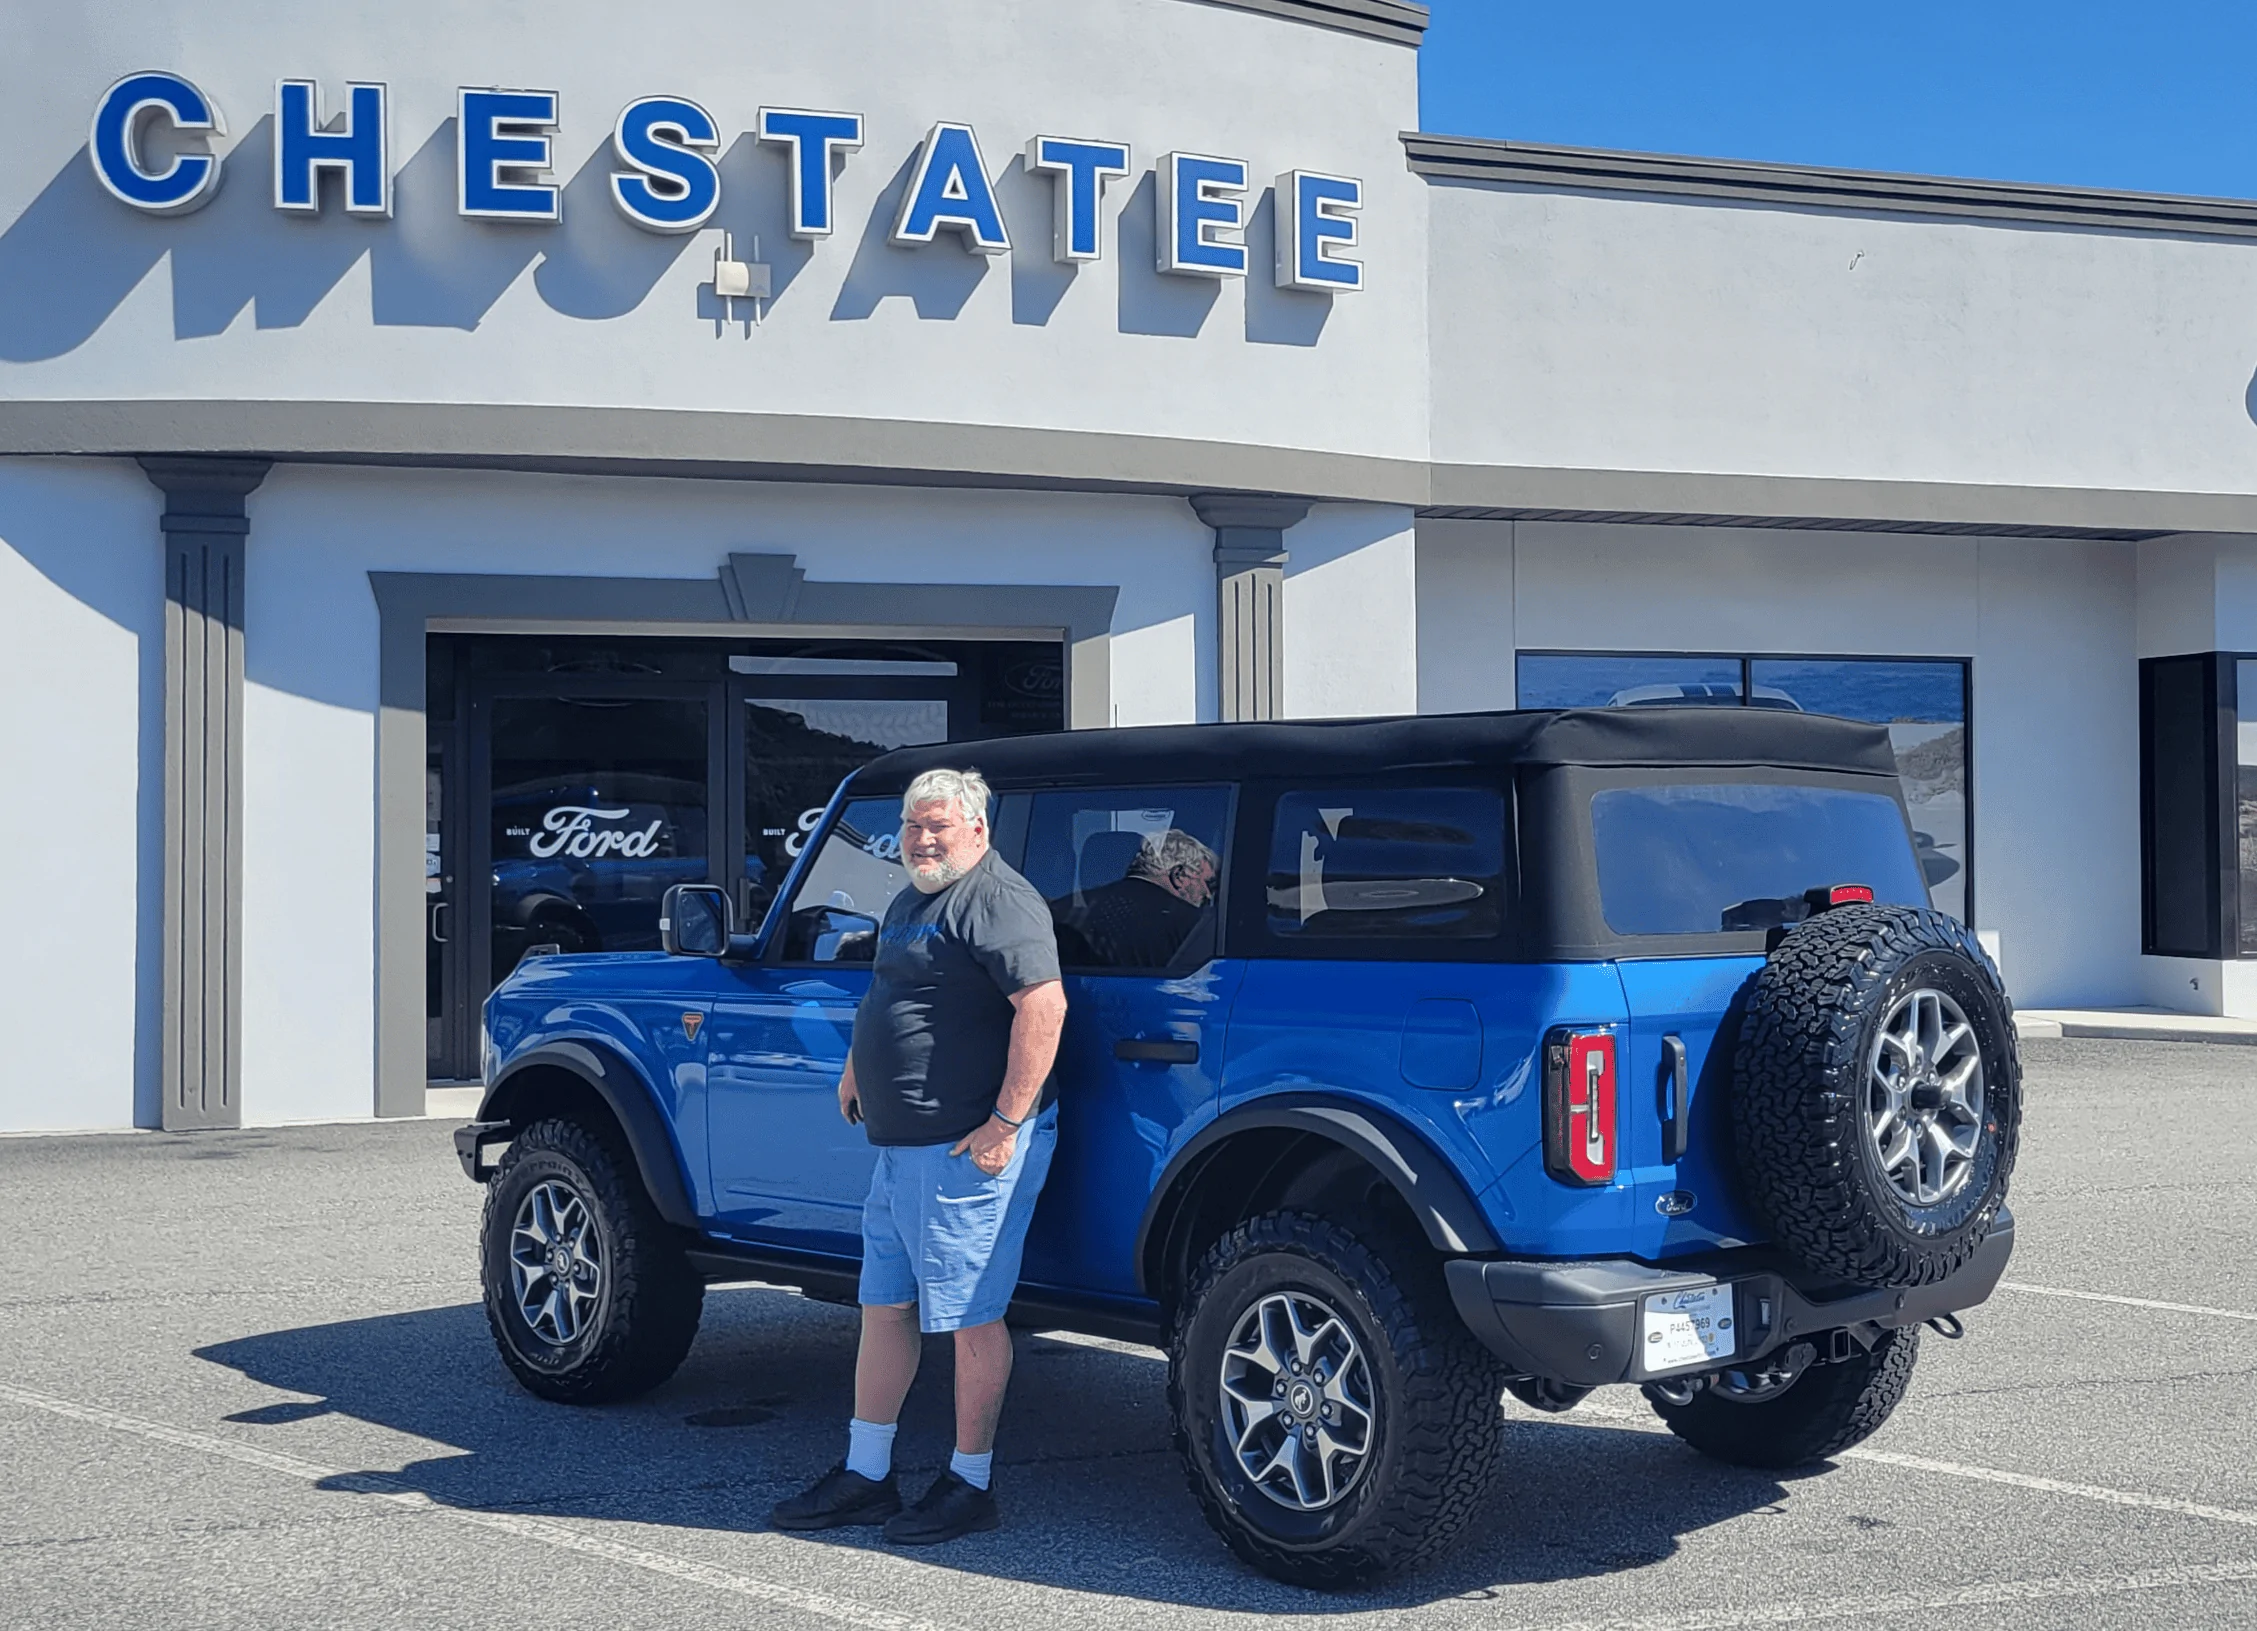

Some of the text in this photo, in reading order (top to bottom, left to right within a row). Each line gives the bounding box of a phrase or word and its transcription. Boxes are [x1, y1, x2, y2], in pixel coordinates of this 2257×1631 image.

[91, 69, 1364, 292] CHESTATEE
[506, 806, 663, 858] BUILT Ford
[762, 828, 786, 836] BUILT
